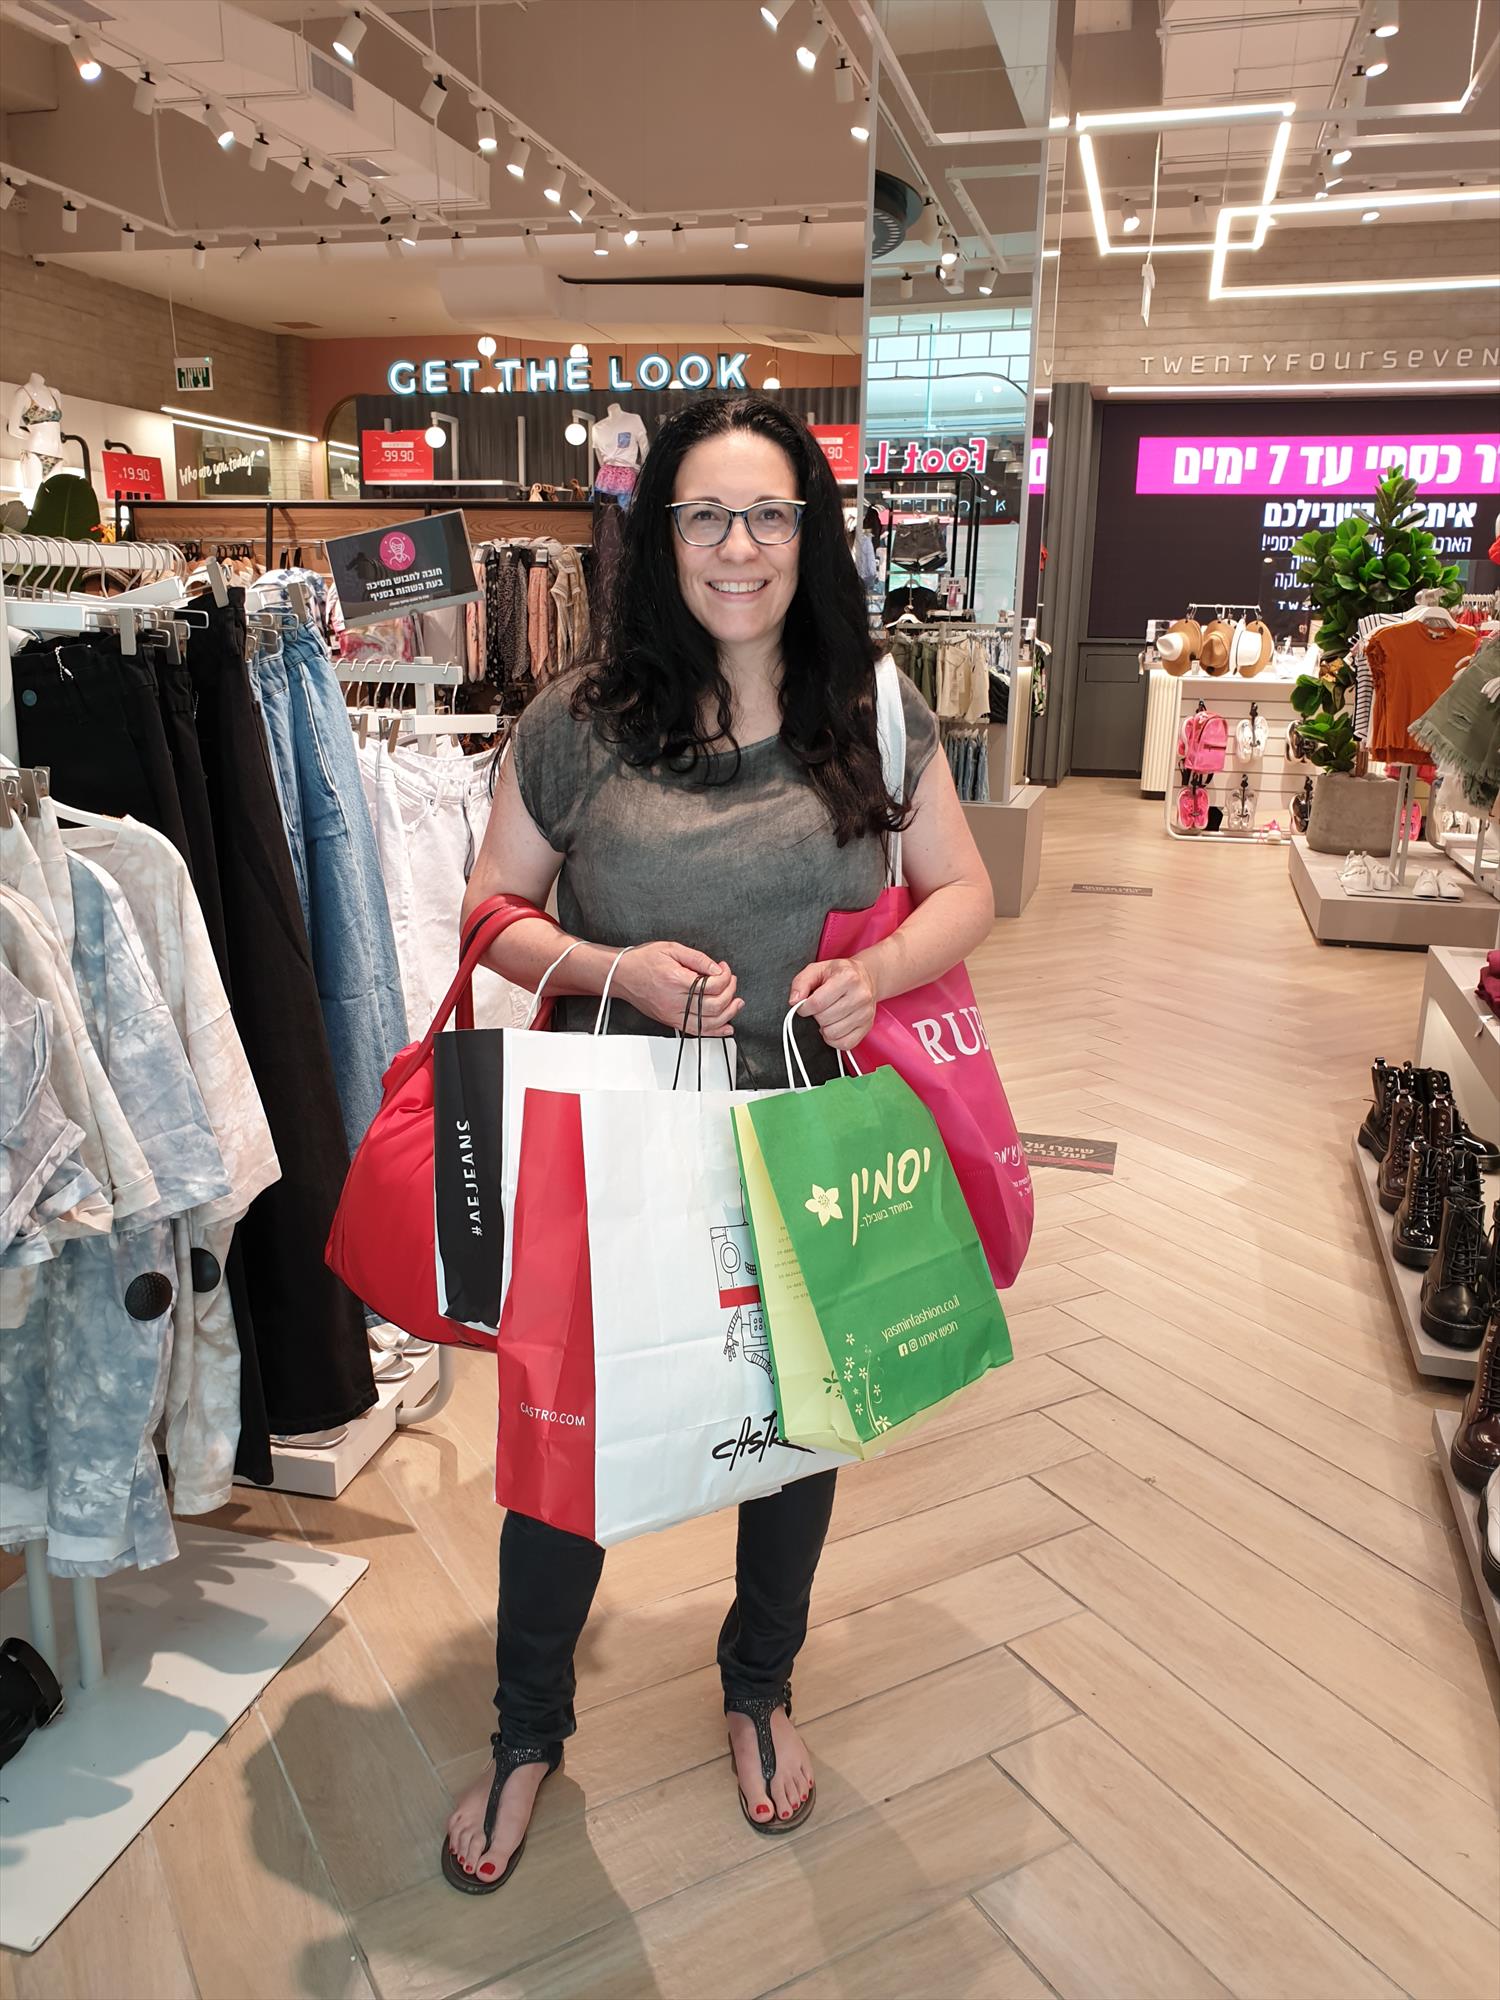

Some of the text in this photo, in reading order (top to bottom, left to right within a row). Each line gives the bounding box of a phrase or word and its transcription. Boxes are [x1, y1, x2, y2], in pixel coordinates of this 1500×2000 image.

[388, 352, 750, 396] GET THE LOOK
[1173, 446, 1258, 485] ימים
[1268, 445, 1291, 485] 7
[1299, 446, 1353, 488] עד
[1365, 445, 1462, 485] כספי
[456, 1120, 483, 1237] #AEJEANS
[851, 1147, 931, 1247] יסמין
[888, 1200, 913, 1215] במיוחד
[881, 1294, 960, 1343] yasminfashion.co.il
[918, 1320, 959, 1348] חפשו אותנו
[520, 1402, 586, 1426] CASTRO.COM
